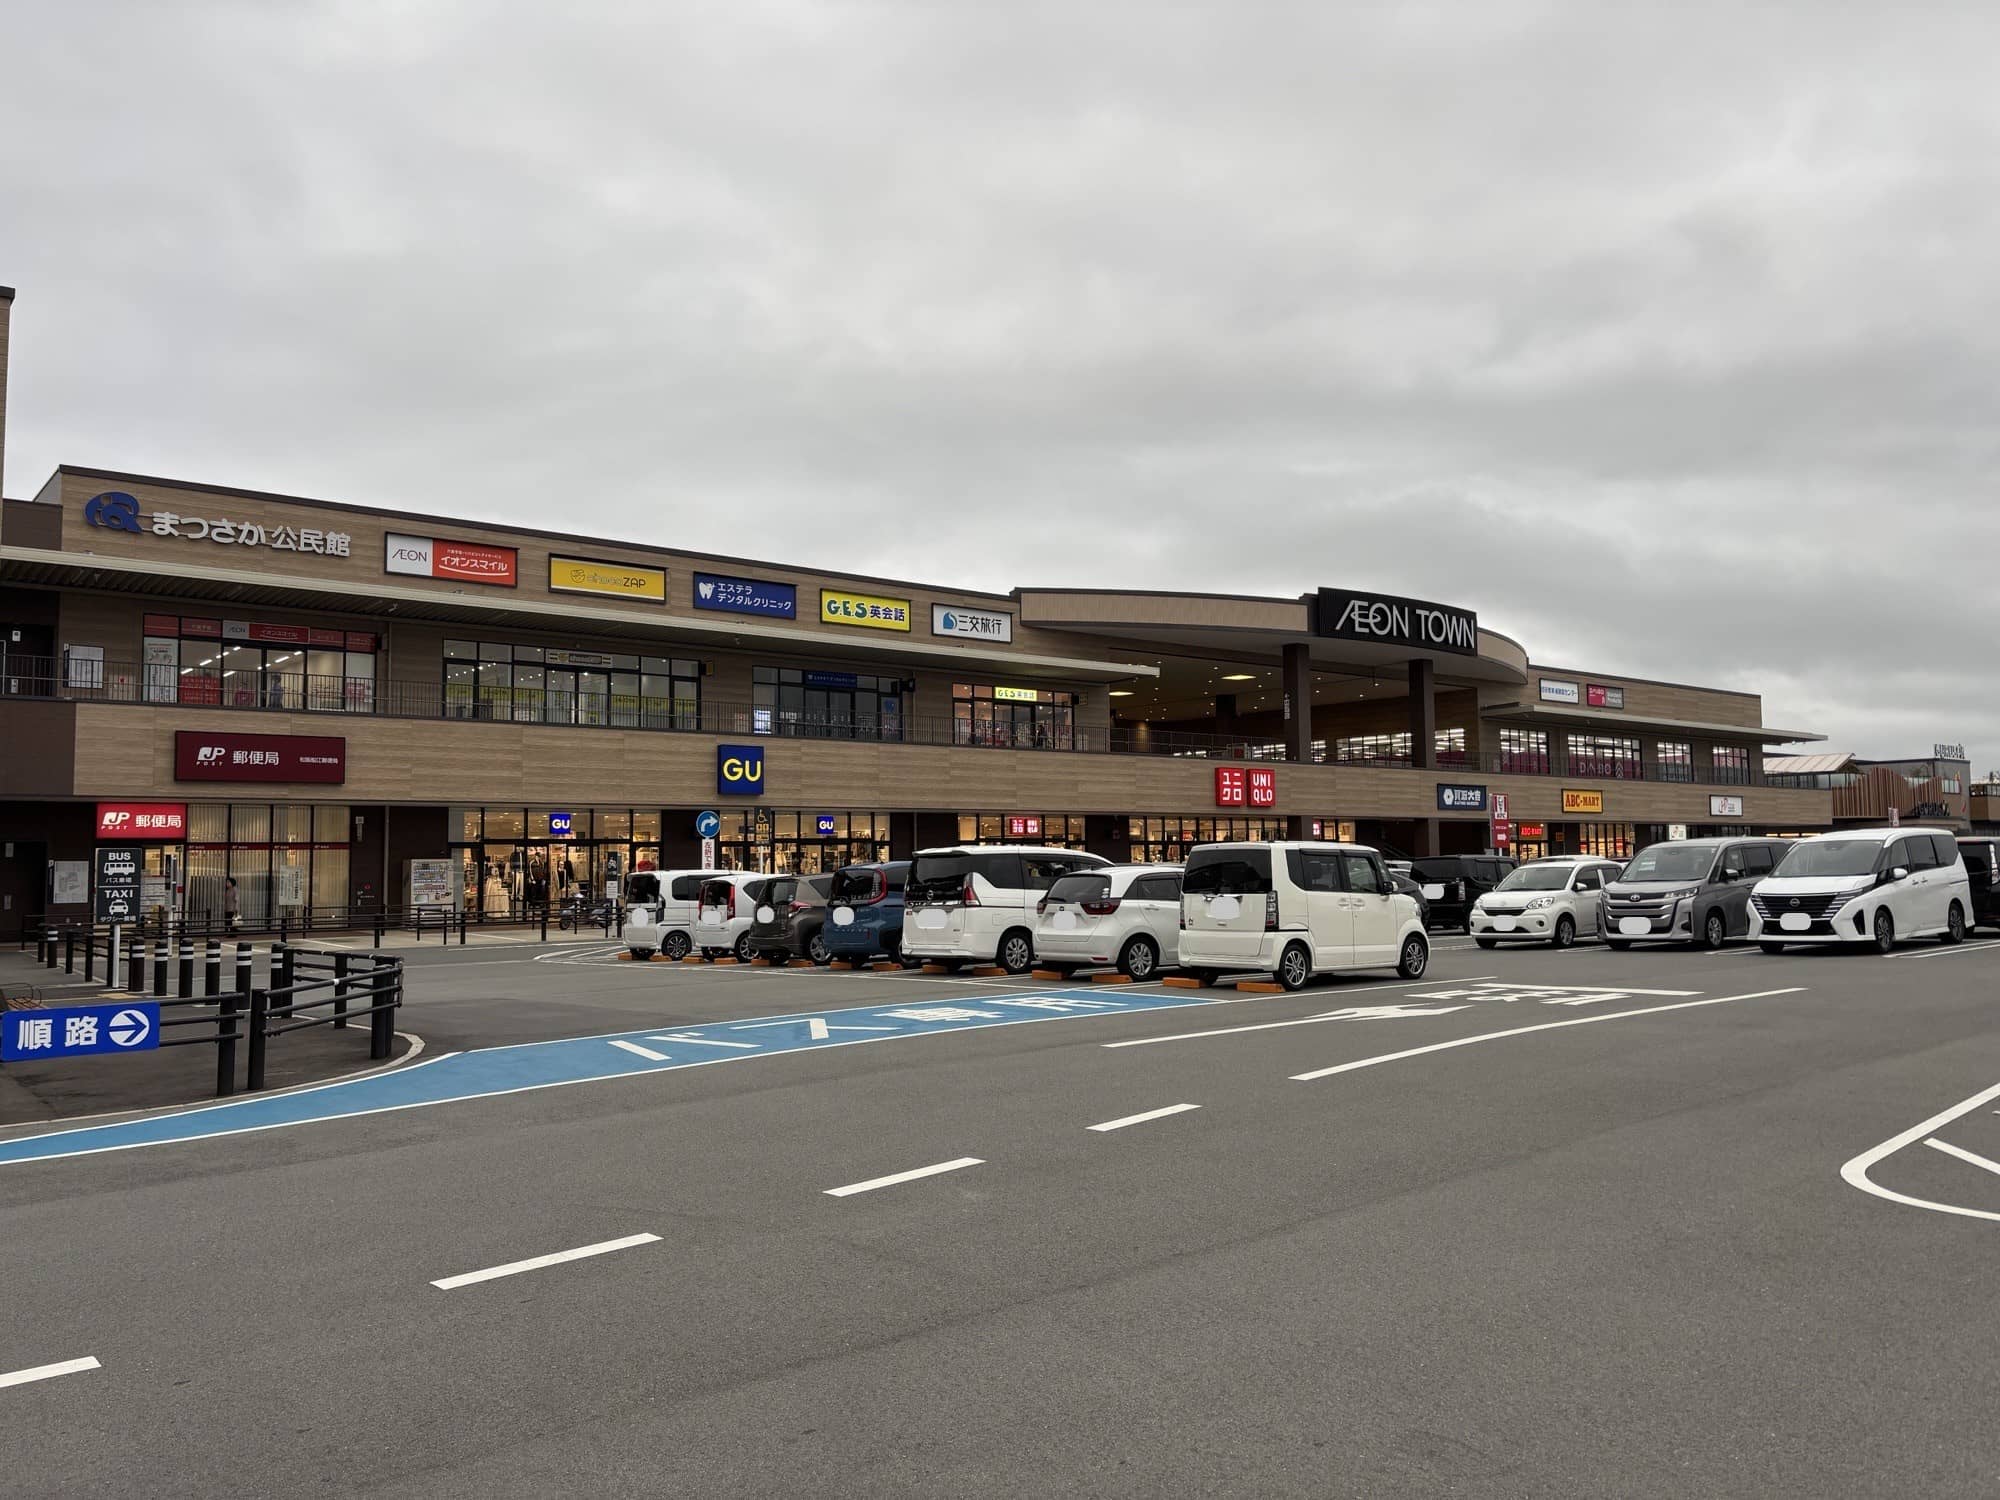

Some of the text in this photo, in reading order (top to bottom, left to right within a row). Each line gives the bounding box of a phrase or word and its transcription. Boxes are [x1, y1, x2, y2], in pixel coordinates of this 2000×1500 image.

[152, 511, 351, 558] まつさか公民館
[440, 556, 508, 572] イオンスマイル
[717, 582, 753, 595] エステラ
[717, 593, 792, 611] デンタルクリニック
[869, 605, 906, 622] 英会話
[957, 615, 1003, 635] 三交旅行
[1415, 609, 1476, 649] TOWN
[232, 750, 280, 766] 郵便局
[722, 758, 762, 782] GU
[1252, 773, 1271, 787] UNI
[1253, 788, 1273, 804] QLO
[135, 814, 182, 828] 郵便局
[552, 819, 570, 829] GU
[819, 820, 834, 830] GU
[108, 852, 131, 860] BUS
[104, 889, 134, 898] TAXI
[17, 1015, 99, 1051] 順路
